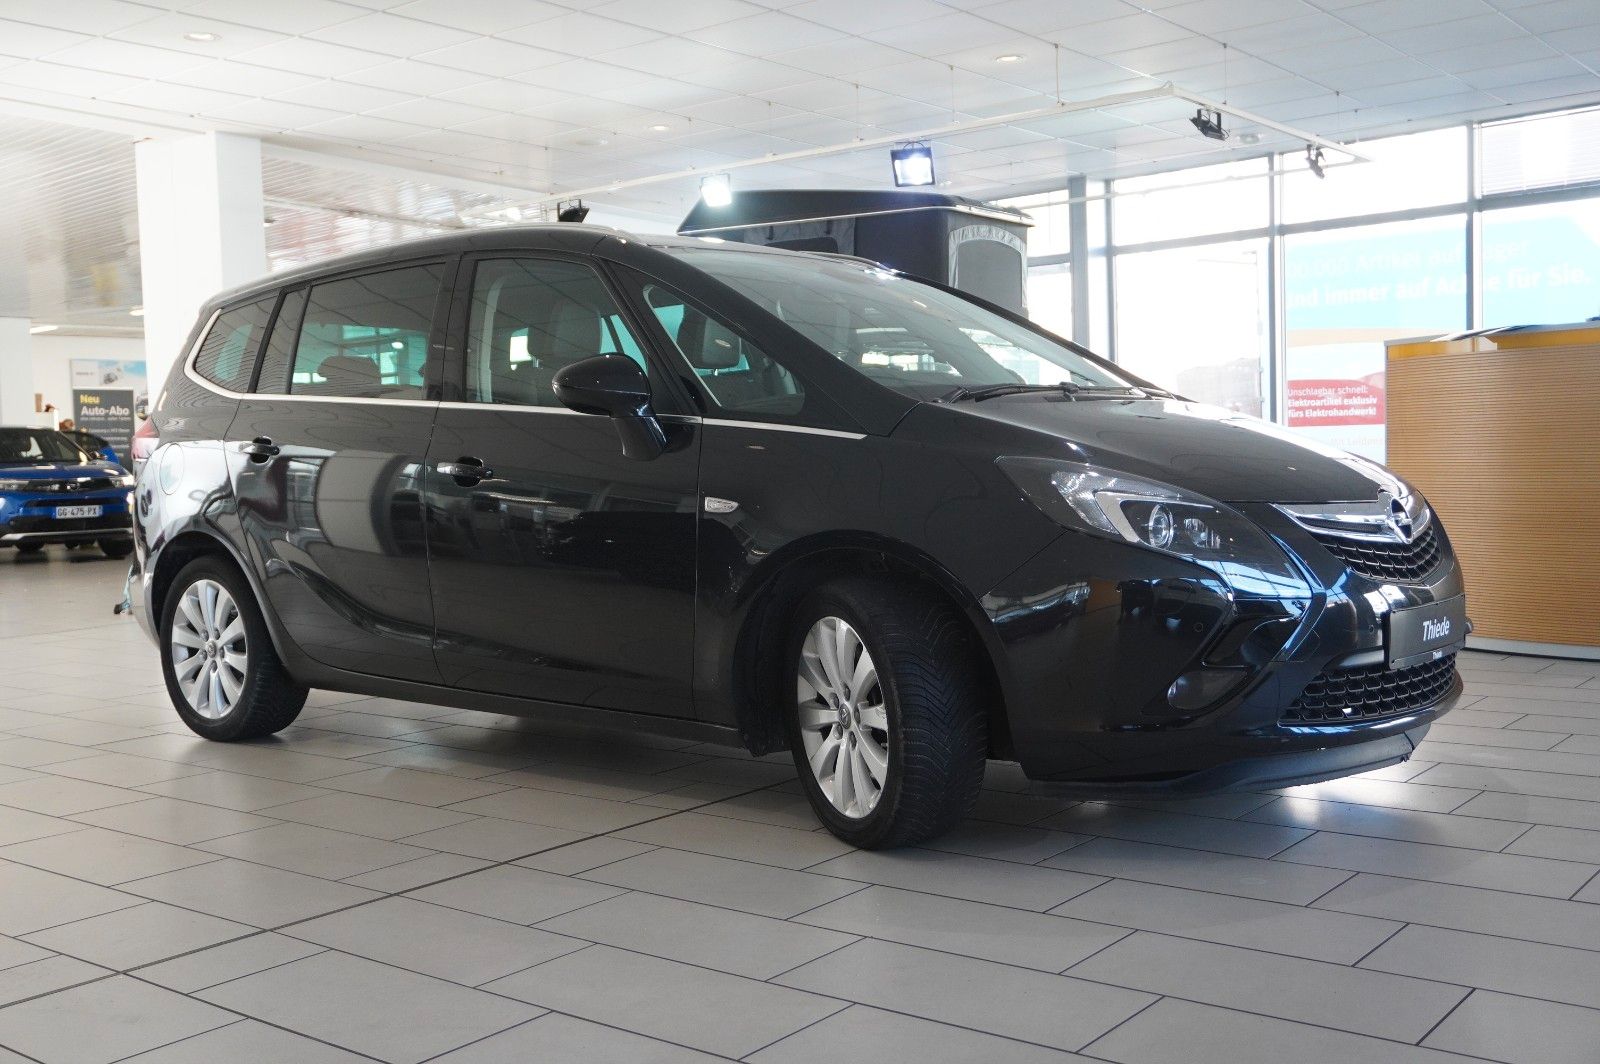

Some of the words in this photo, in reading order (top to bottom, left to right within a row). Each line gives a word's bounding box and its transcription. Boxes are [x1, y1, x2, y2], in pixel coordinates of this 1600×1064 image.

[1325, 284, 1389, 304] immer
[1396, 276, 1429, 299] auf
[1506, 267, 1540, 289] für
[1288, 388, 1335, 397] Unschlagbar
[80, 394, 100, 404] Neu
[1288, 398, 1342, 407] Elektroartikel
[1344, 396, 1377, 404] exklusiv
[81, 405, 130, 416] Auto-Abo
[1288, 408, 1304, 417] fürs
[1305, 407, 1376, 417] Elektrohandwerk!
[1423, 616, 1450, 641] Thiede
